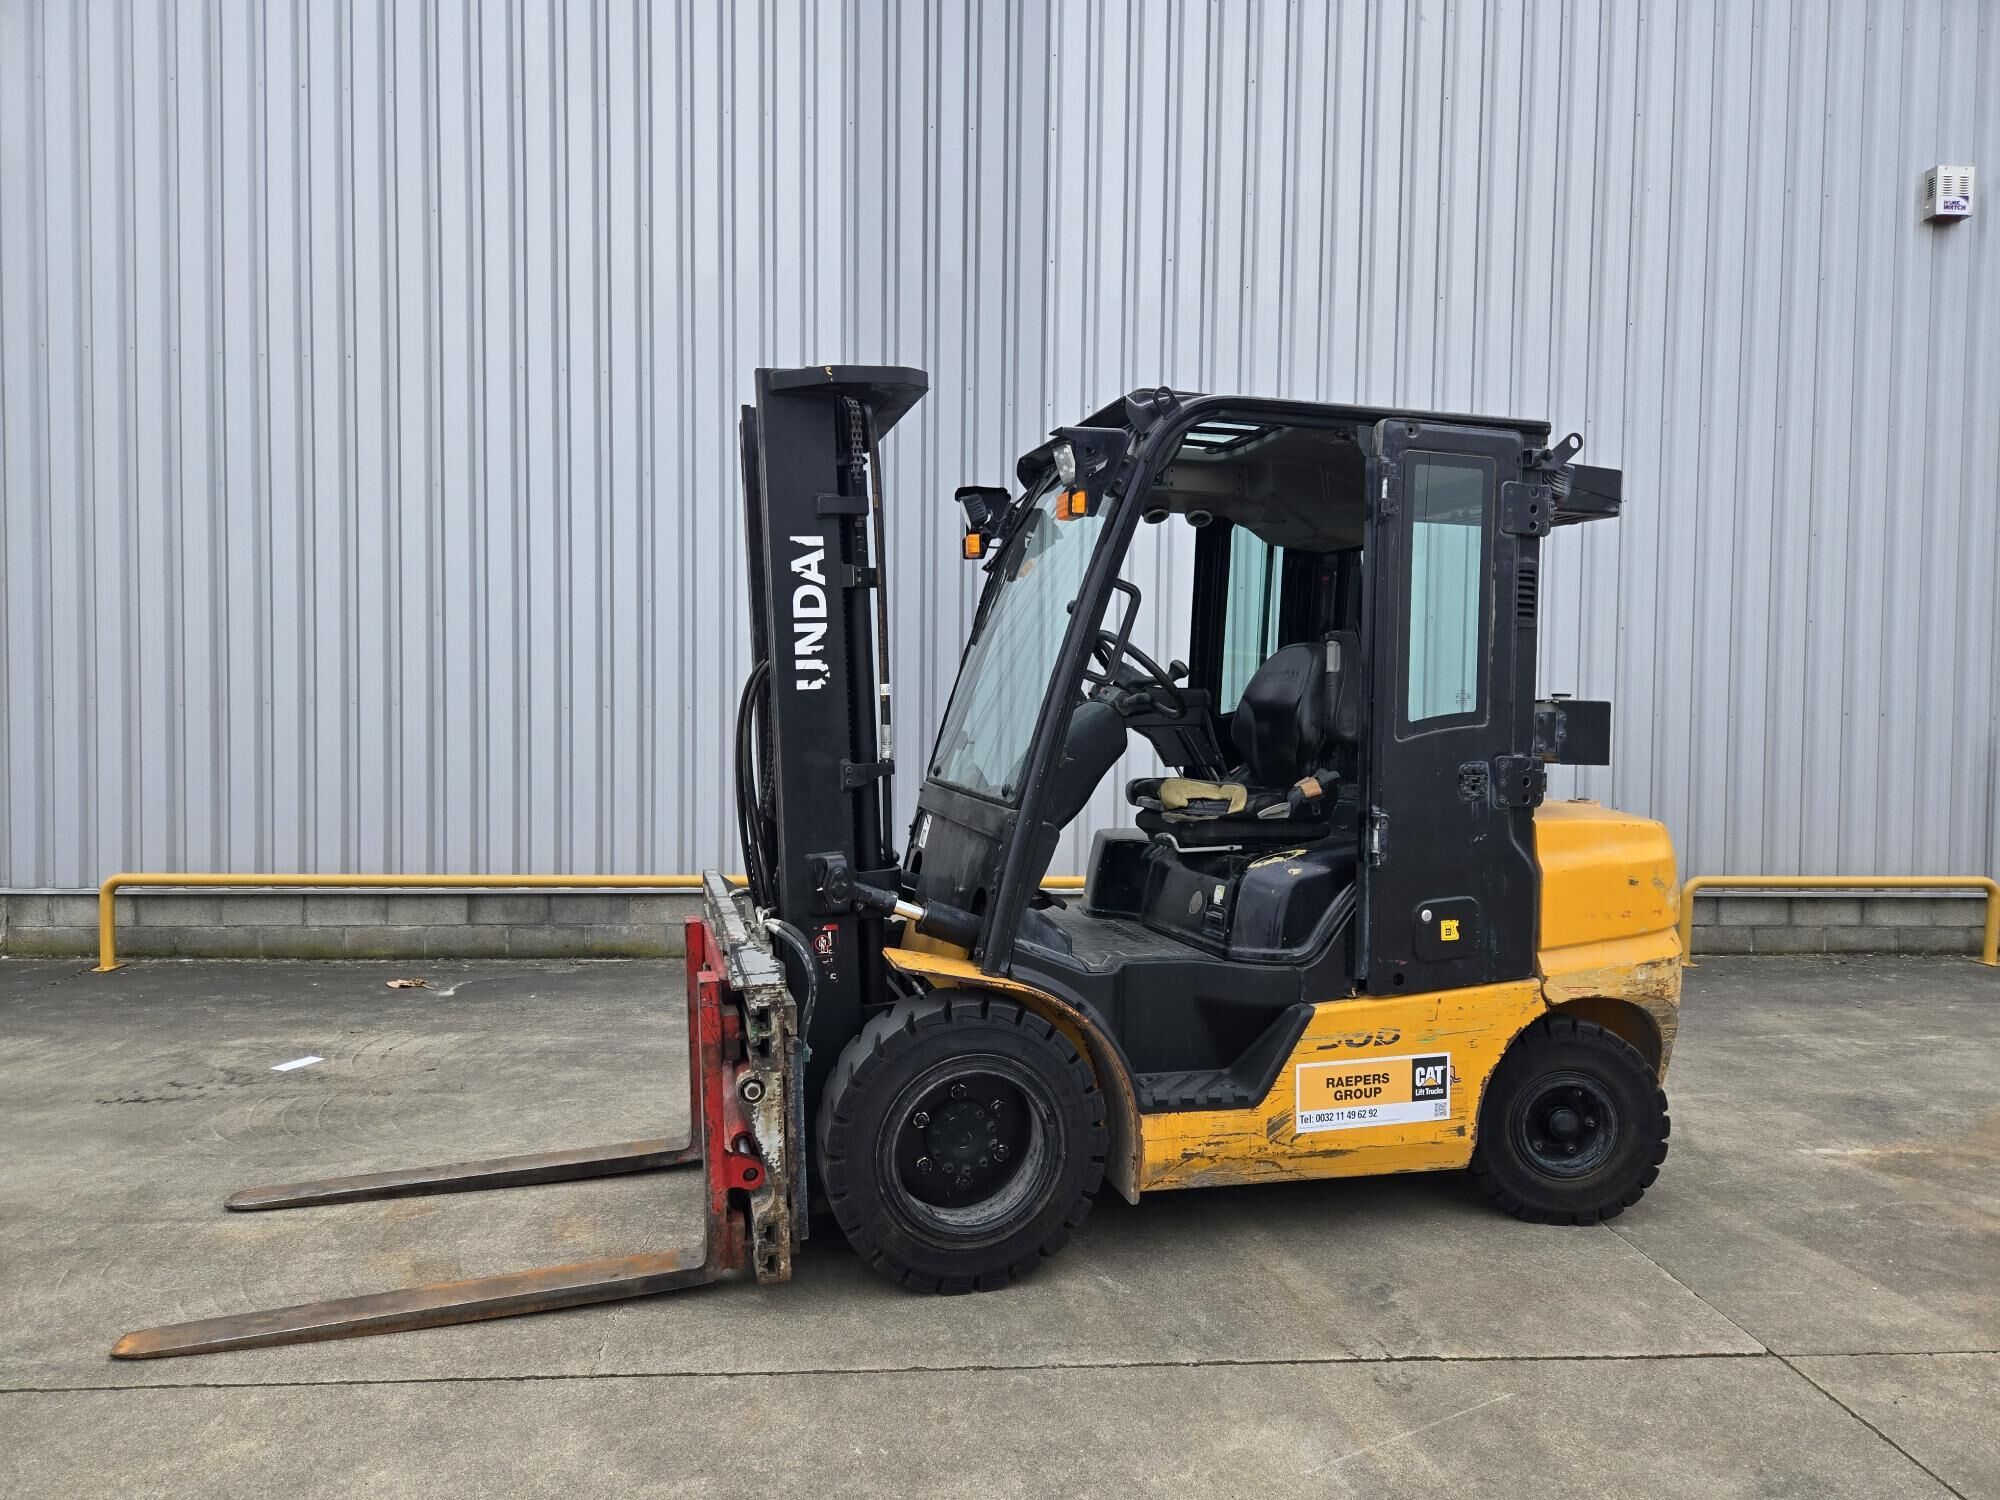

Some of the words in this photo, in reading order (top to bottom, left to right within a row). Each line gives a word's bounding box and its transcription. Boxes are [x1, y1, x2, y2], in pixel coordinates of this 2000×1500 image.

[1326, 1073, 1389, 1088] RAEPERS
[1415, 1065, 1444, 1087] CAT
[1333, 1087, 1382, 1101] GROUP
[1415, 1088, 1425, 1096] Lift
[1425, 1087, 1444, 1095] Trucks
[1299, 1114, 1314, 1124] Tel:
[1315, 1112, 1334, 1123] 0032
[1336, 1111, 1344, 1121] 11
[1346, 1110, 1356, 1120] 49
[1357, 1109, 1367, 1119] 62
[1368, 1108, 1378, 1118] 92
